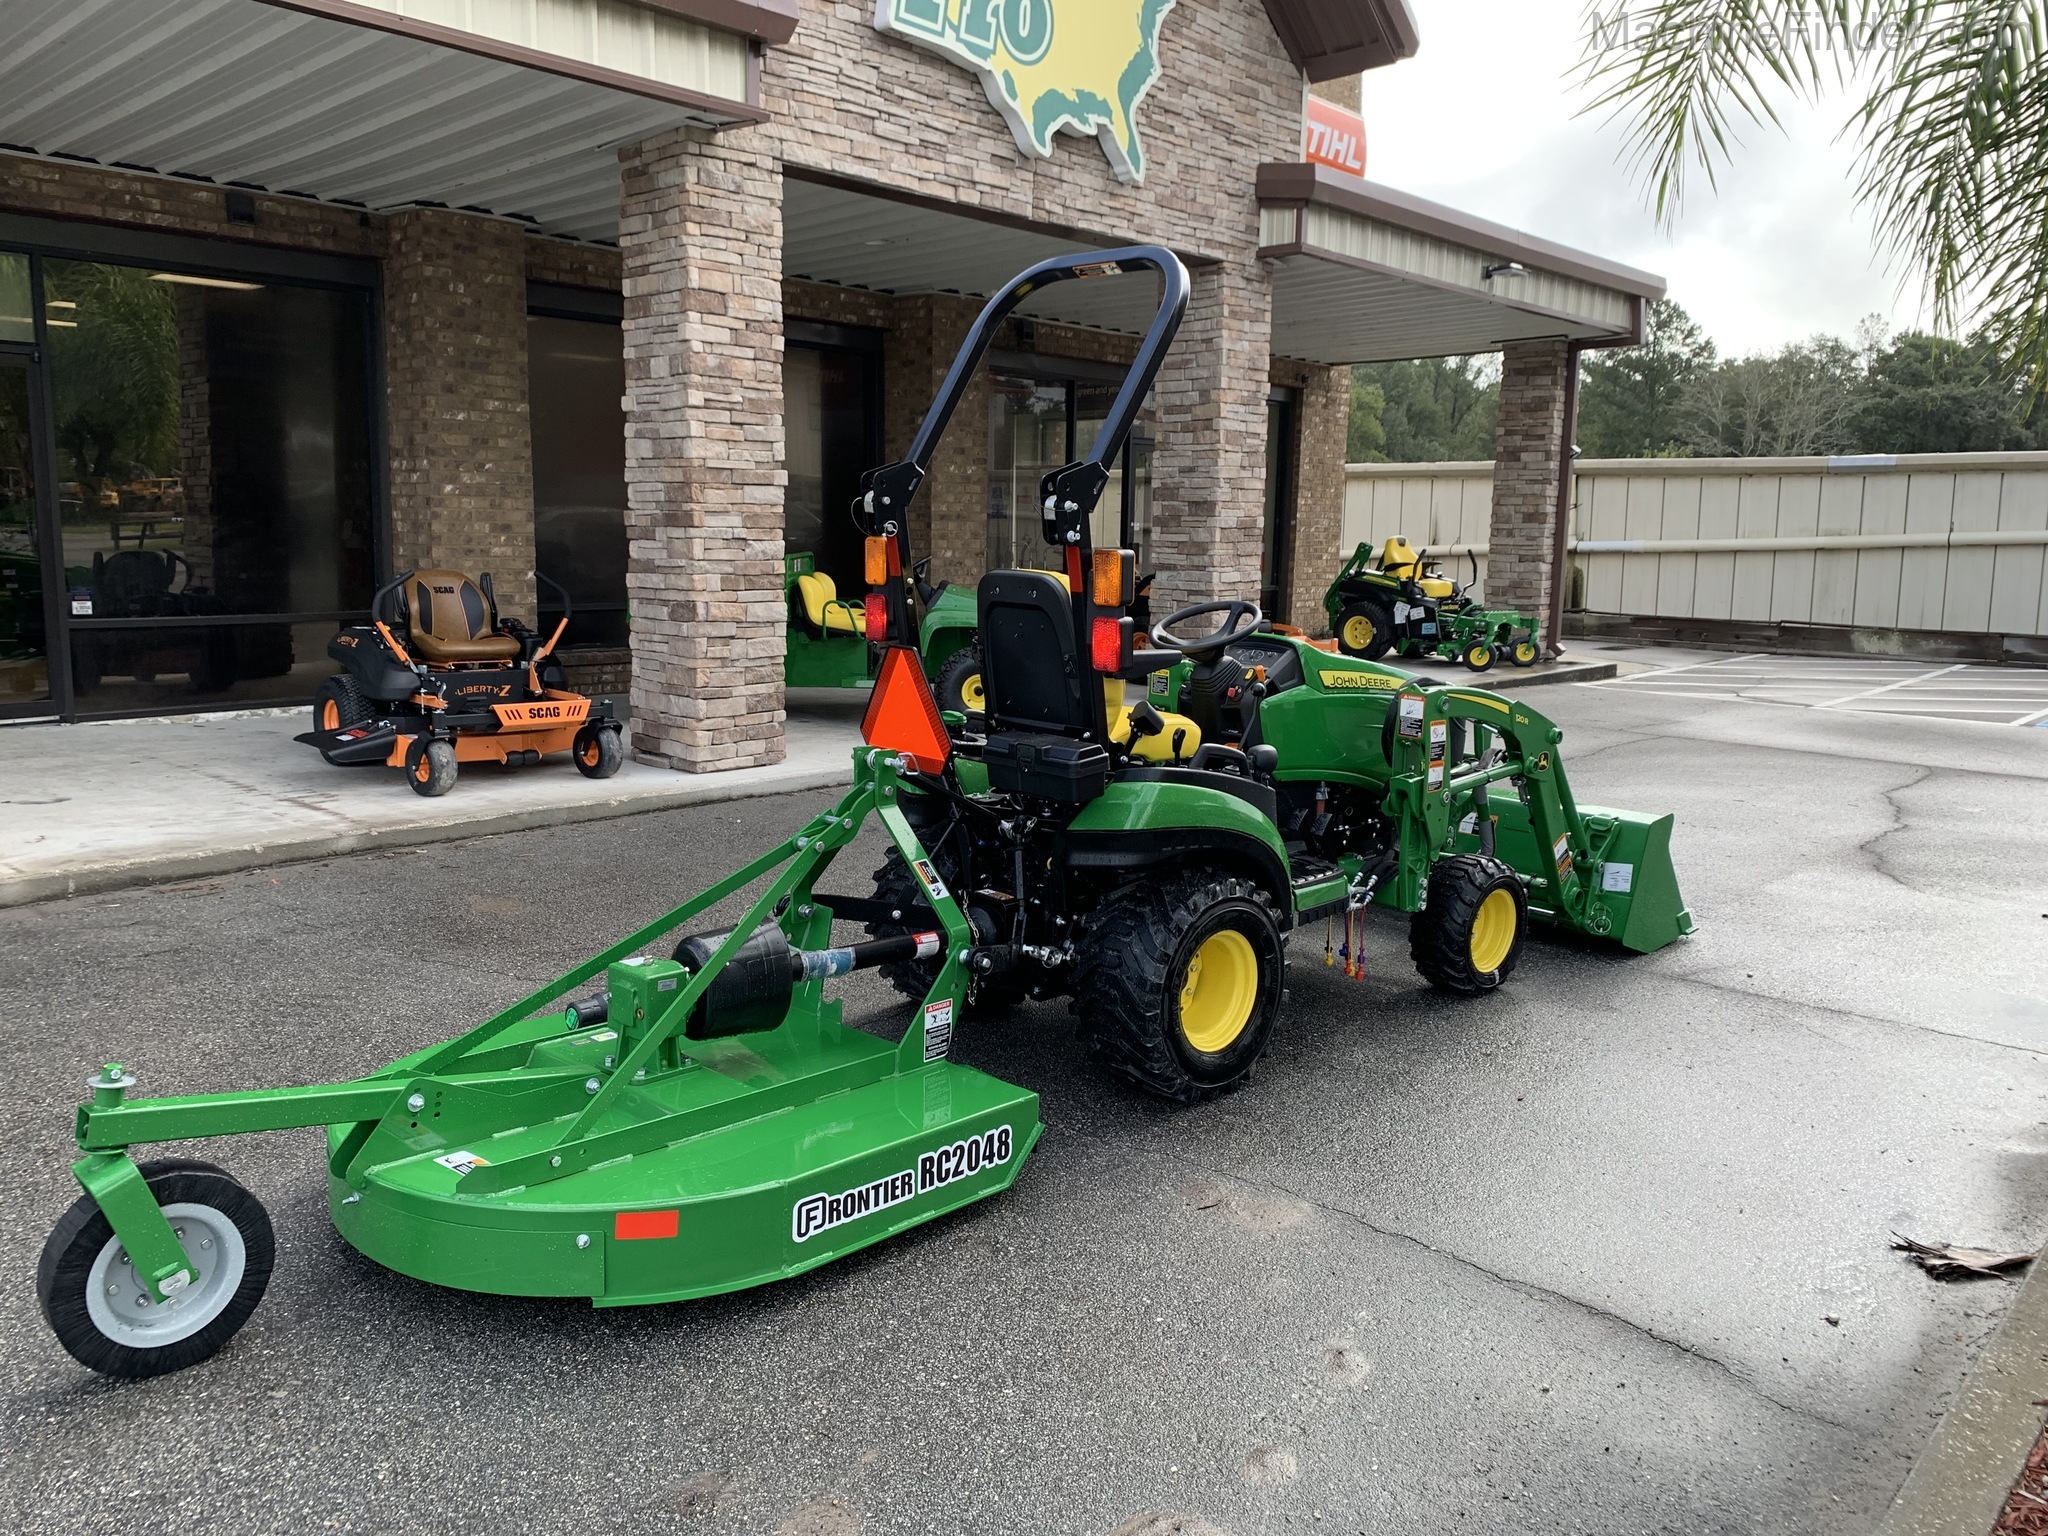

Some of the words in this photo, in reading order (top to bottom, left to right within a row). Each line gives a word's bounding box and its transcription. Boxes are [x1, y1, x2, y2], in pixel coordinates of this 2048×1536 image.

[1307, 118, 1361, 170] TIHL
[433, 586, 455, 594] SCAG
[1330, 675, 1358, 686] JOHN
[1359, 675, 1392, 688] DEERE
[456, 684, 500, 696] LIBERTY
[528, 706, 561, 719] SCAG
[796, 1172, 913, 1238] FRONTIER
[919, 1128, 1010, 1190] RC2048
